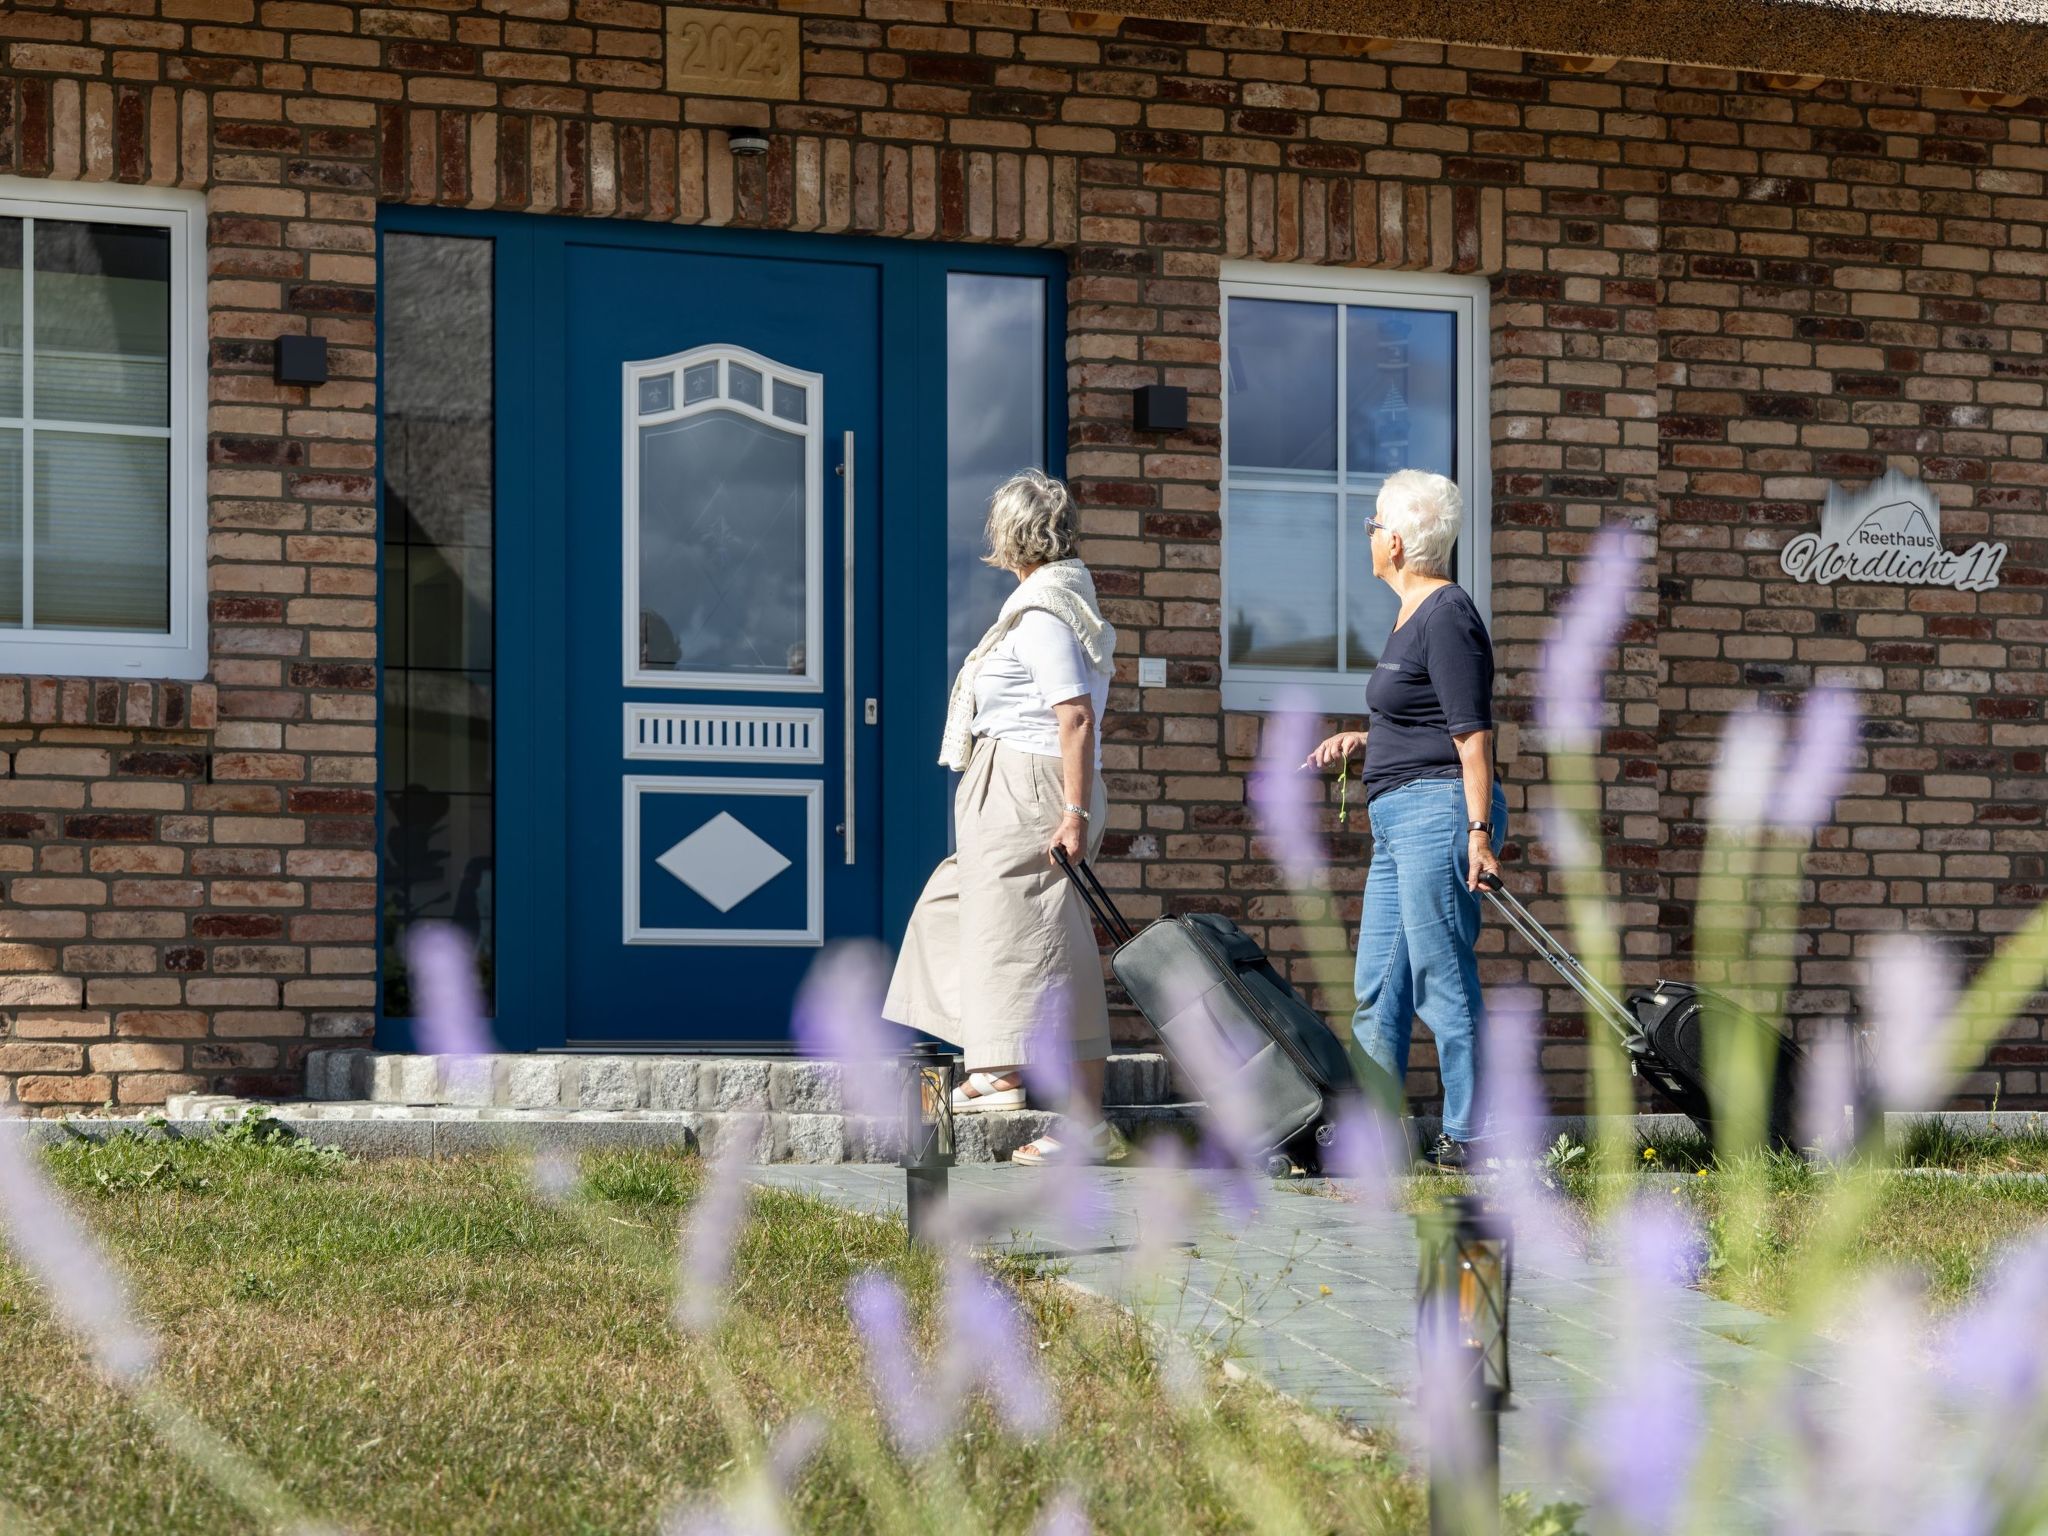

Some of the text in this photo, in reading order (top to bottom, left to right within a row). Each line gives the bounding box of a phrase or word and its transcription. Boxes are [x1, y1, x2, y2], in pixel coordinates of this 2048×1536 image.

[680, 21, 787, 86] 2023
[1785, 538, 2002, 585] Nordlicht 11
[1859, 530, 1935, 548] Reethaus
